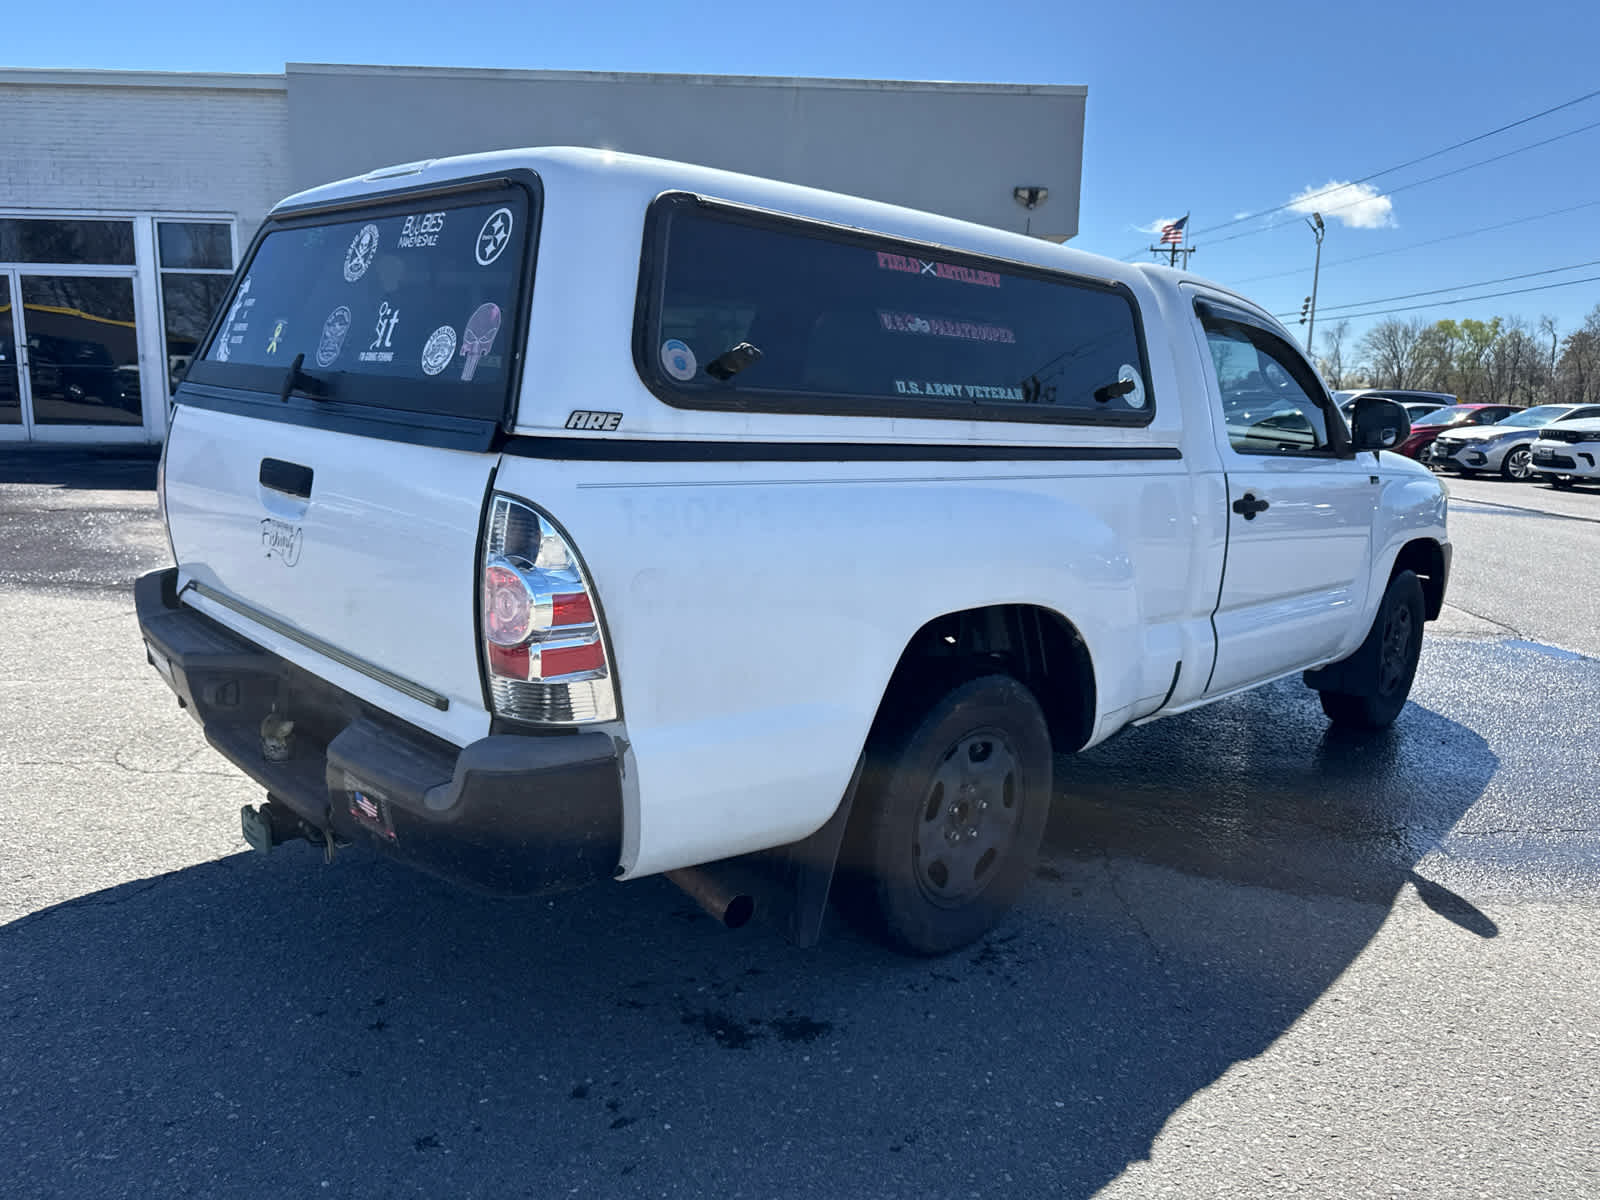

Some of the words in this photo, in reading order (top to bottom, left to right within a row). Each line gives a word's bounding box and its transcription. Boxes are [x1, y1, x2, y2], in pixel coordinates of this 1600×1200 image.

[877, 251, 920, 274] FIELD
[935, 262, 1000, 288] ARTILLERY
[895, 380, 924, 395] U.S.
[925, 383, 963, 398] ARMY
[964, 385, 1024, 401] VETERAN
[564, 410, 623, 431] ARE
